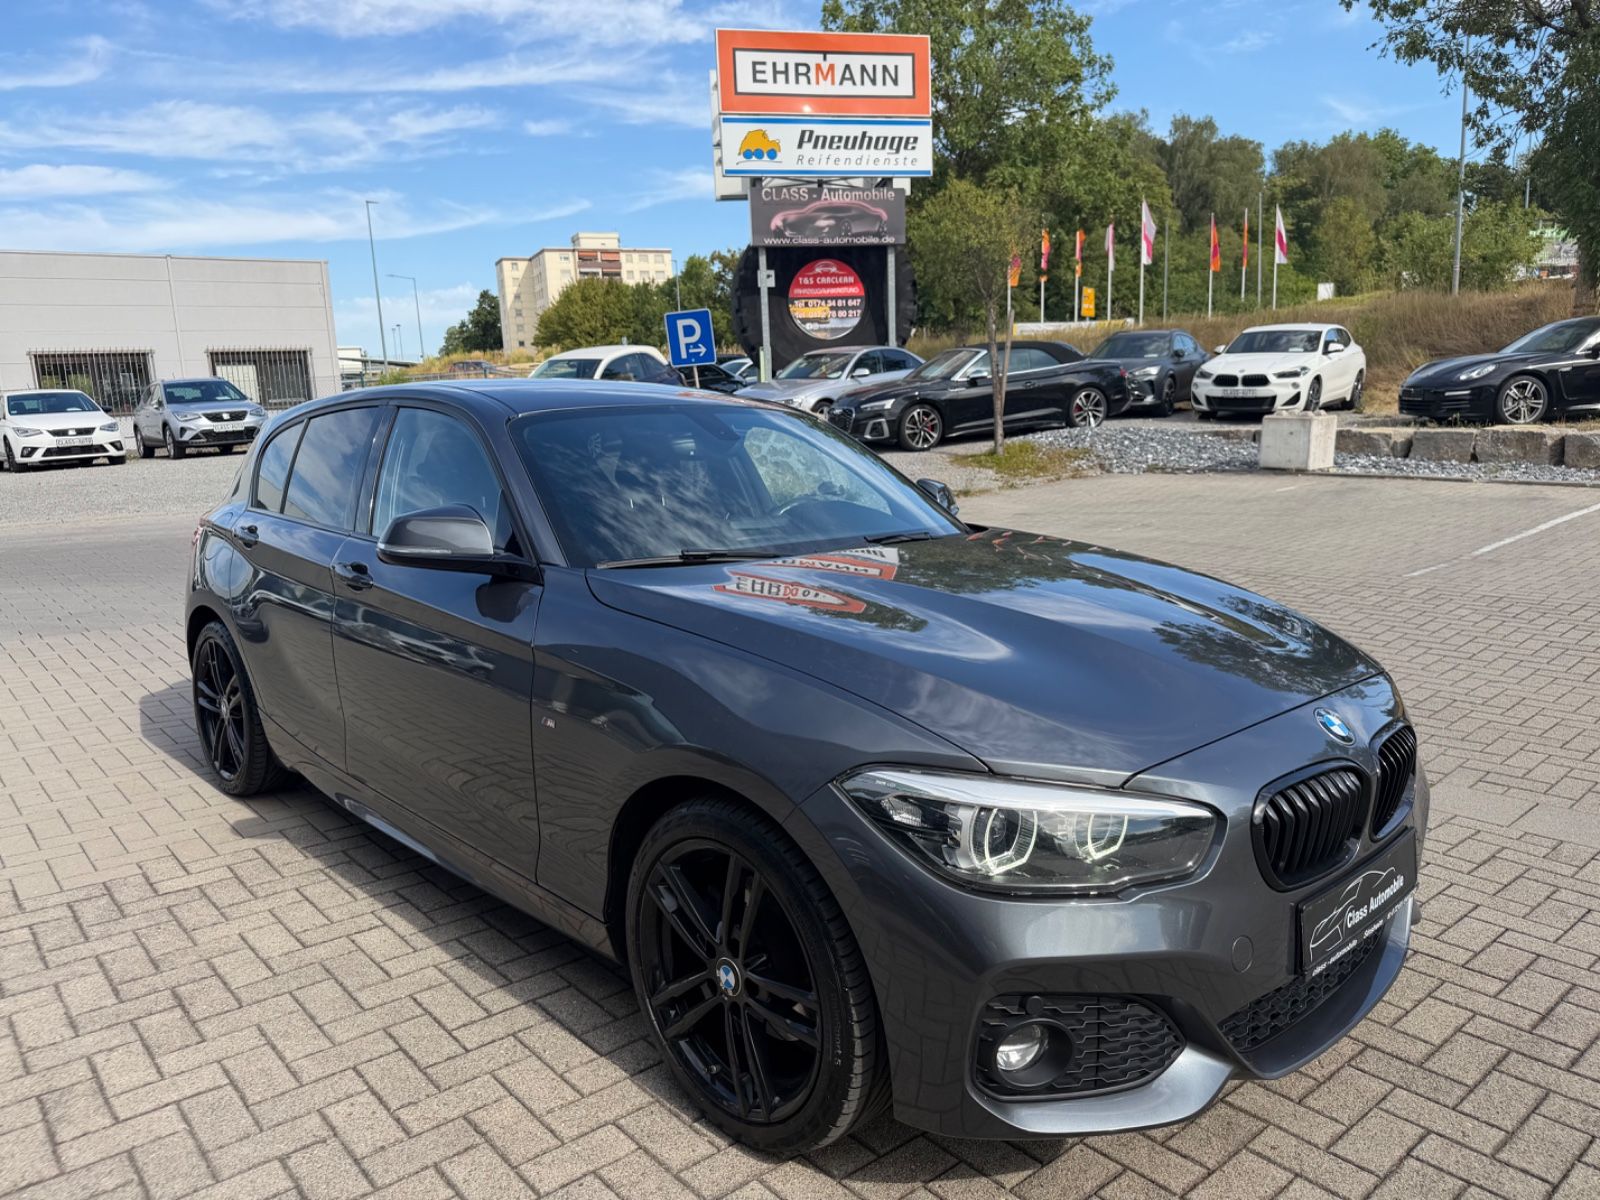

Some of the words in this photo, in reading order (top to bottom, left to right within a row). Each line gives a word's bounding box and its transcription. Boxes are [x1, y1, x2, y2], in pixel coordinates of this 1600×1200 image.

[751, 61, 899, 87] EHRMANN
[796, 129, 919, 155] Pneuhage
[796, 154, 918, 167] Reifendienste
[761, 188, 809, 201] CLASS
[821, 188, 896, 201] Automobile
[763, 235, 896, 244] www.class-automobile.de
[826, 299, 836, 307] 34
[847, 299, 861, 307] 647
[675, 318, 702, 360] P
[1346, 904, 1368, 929] Class
[1369, 874, 1404, 912] Automobile
